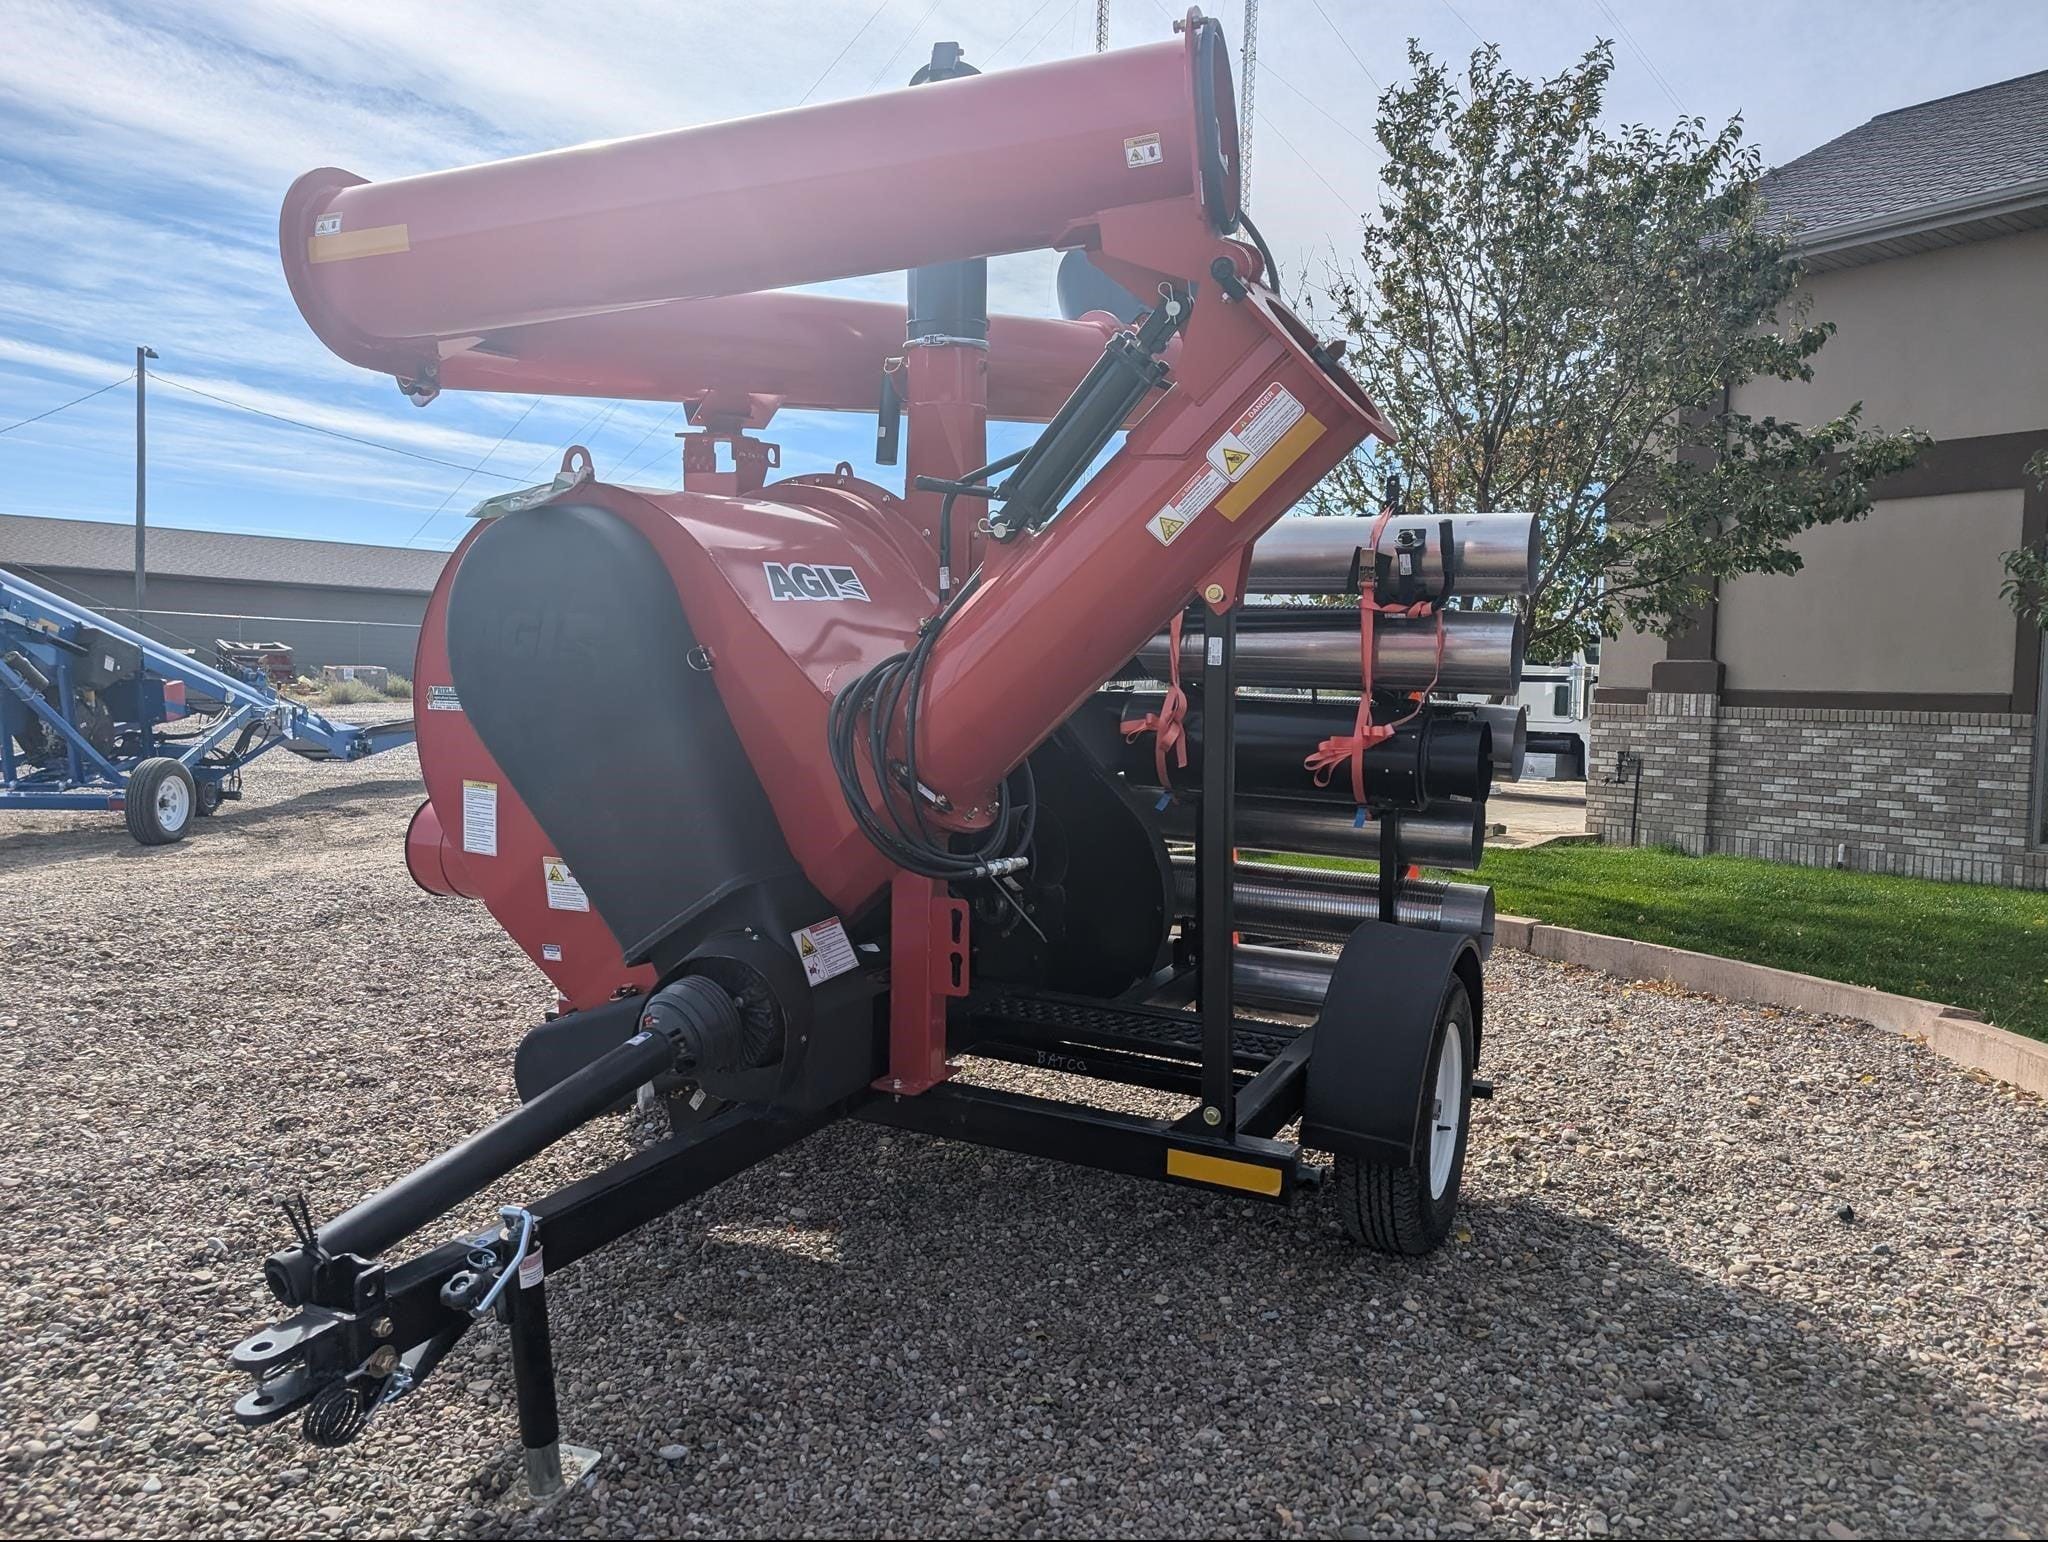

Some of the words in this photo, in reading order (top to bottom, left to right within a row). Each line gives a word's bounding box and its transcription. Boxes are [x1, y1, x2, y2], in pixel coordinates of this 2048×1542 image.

[1247, 389, 1275, 418] DANGER
[764, 559, 842, 600] AGI
[1036, 1050, 1087, 1071] BATCO
